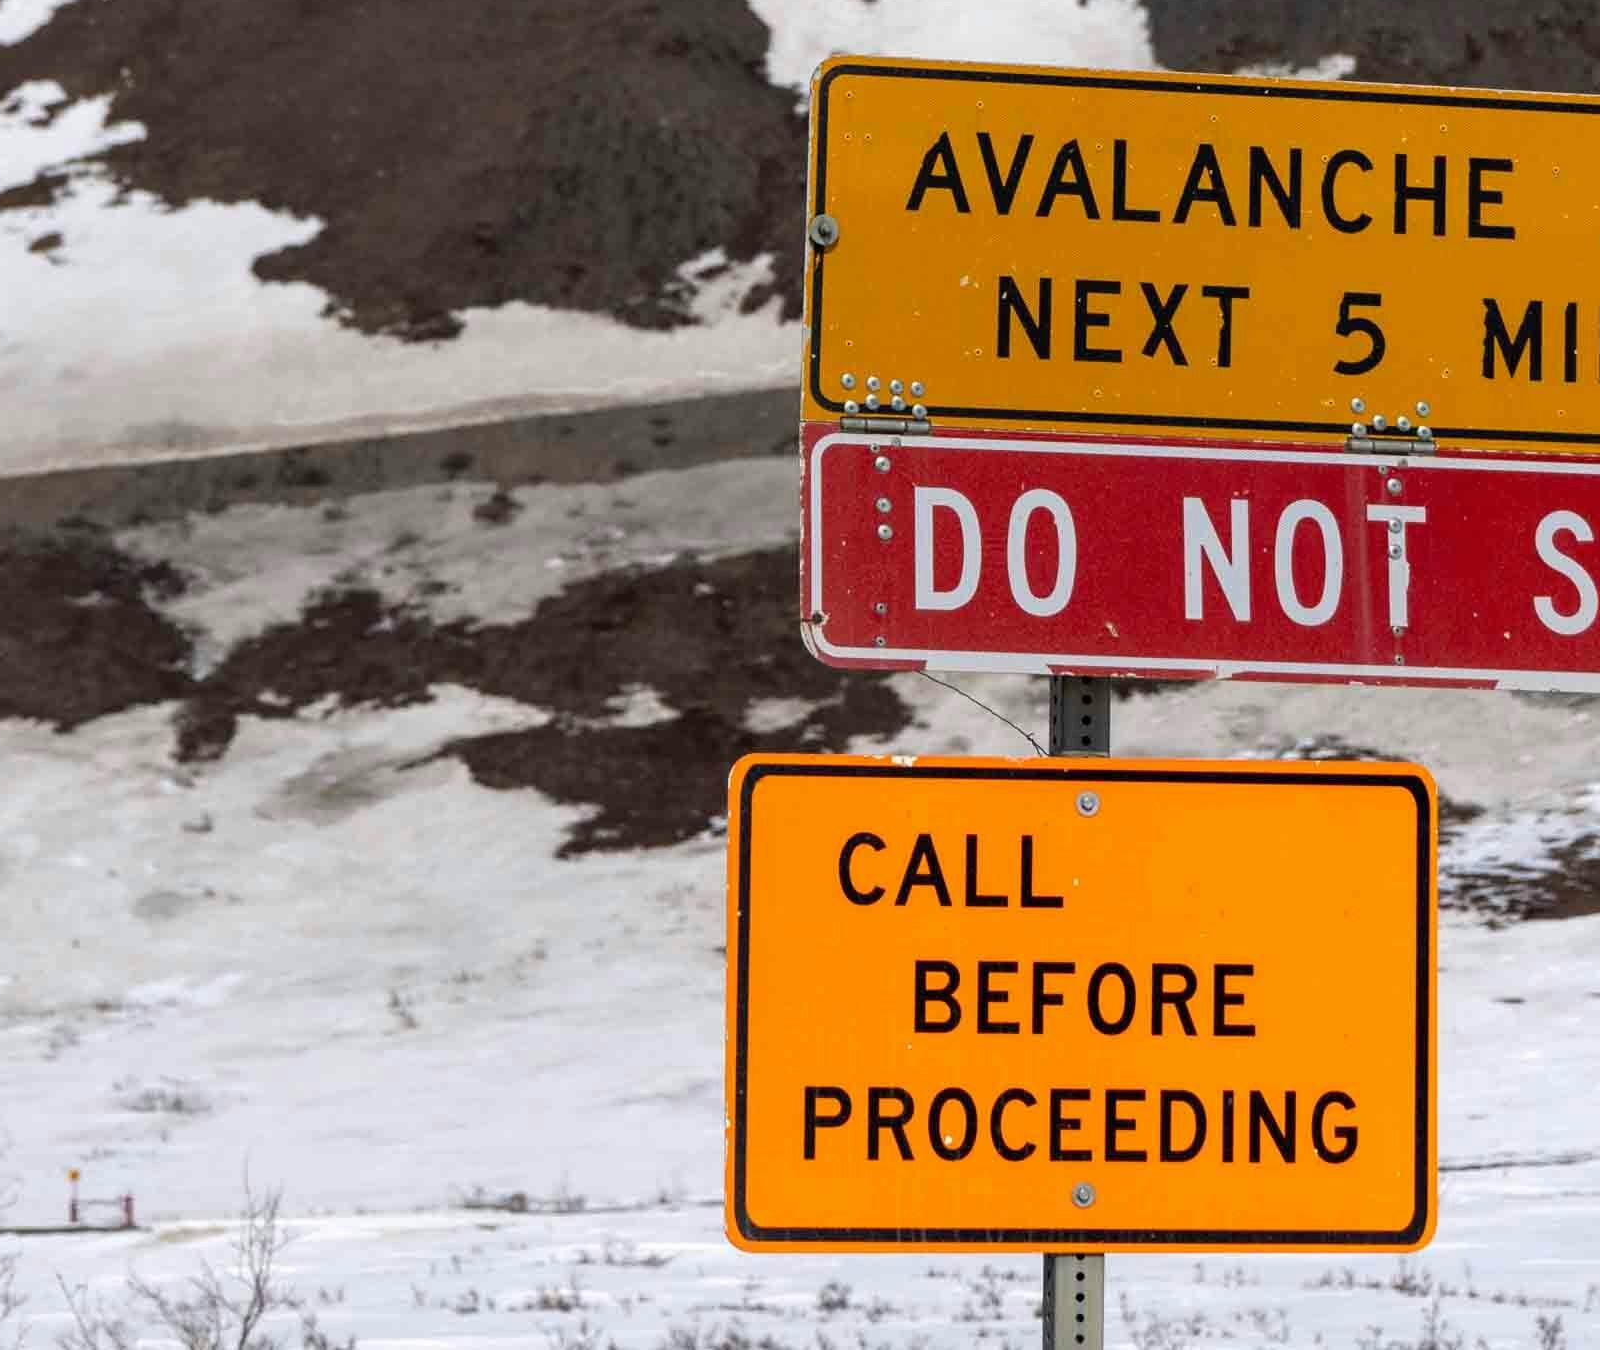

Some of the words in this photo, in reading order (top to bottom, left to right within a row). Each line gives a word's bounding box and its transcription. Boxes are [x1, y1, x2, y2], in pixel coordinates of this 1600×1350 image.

[907, 131, 1516, 240] AVALANCHE
[997, 276, 1250, 368] NEXT
[1334, 292, 1387, 376] 5
[914, 487, 1078, 617] DO
[1184, 497, 1426, 628] NOT
[838, 832, 1064, 908] CALL
[914, 960, 1256, 1037] BEFORE
[803, 1086, 1359, 1164] PROCEEDING
